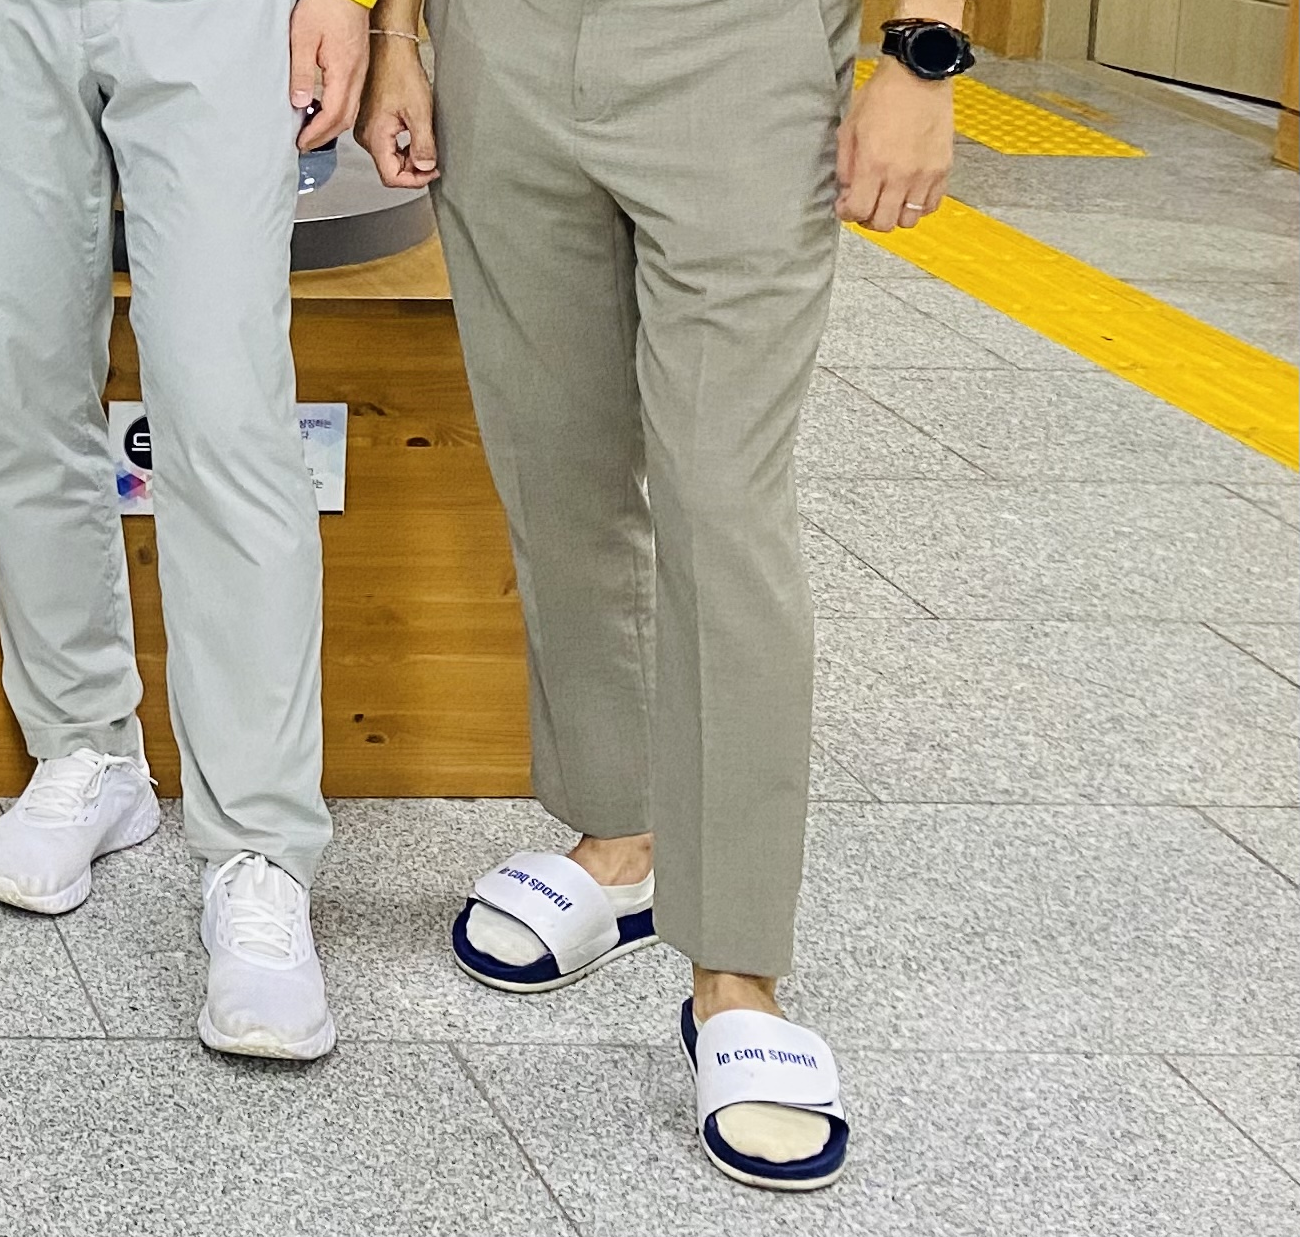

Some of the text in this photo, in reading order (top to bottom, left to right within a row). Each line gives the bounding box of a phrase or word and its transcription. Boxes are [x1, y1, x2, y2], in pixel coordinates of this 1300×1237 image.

[507, 869, 530, 884] coq
[528, 878, 574, 912] sportif
[716, 1048, 818, 1069] le coq sportif
